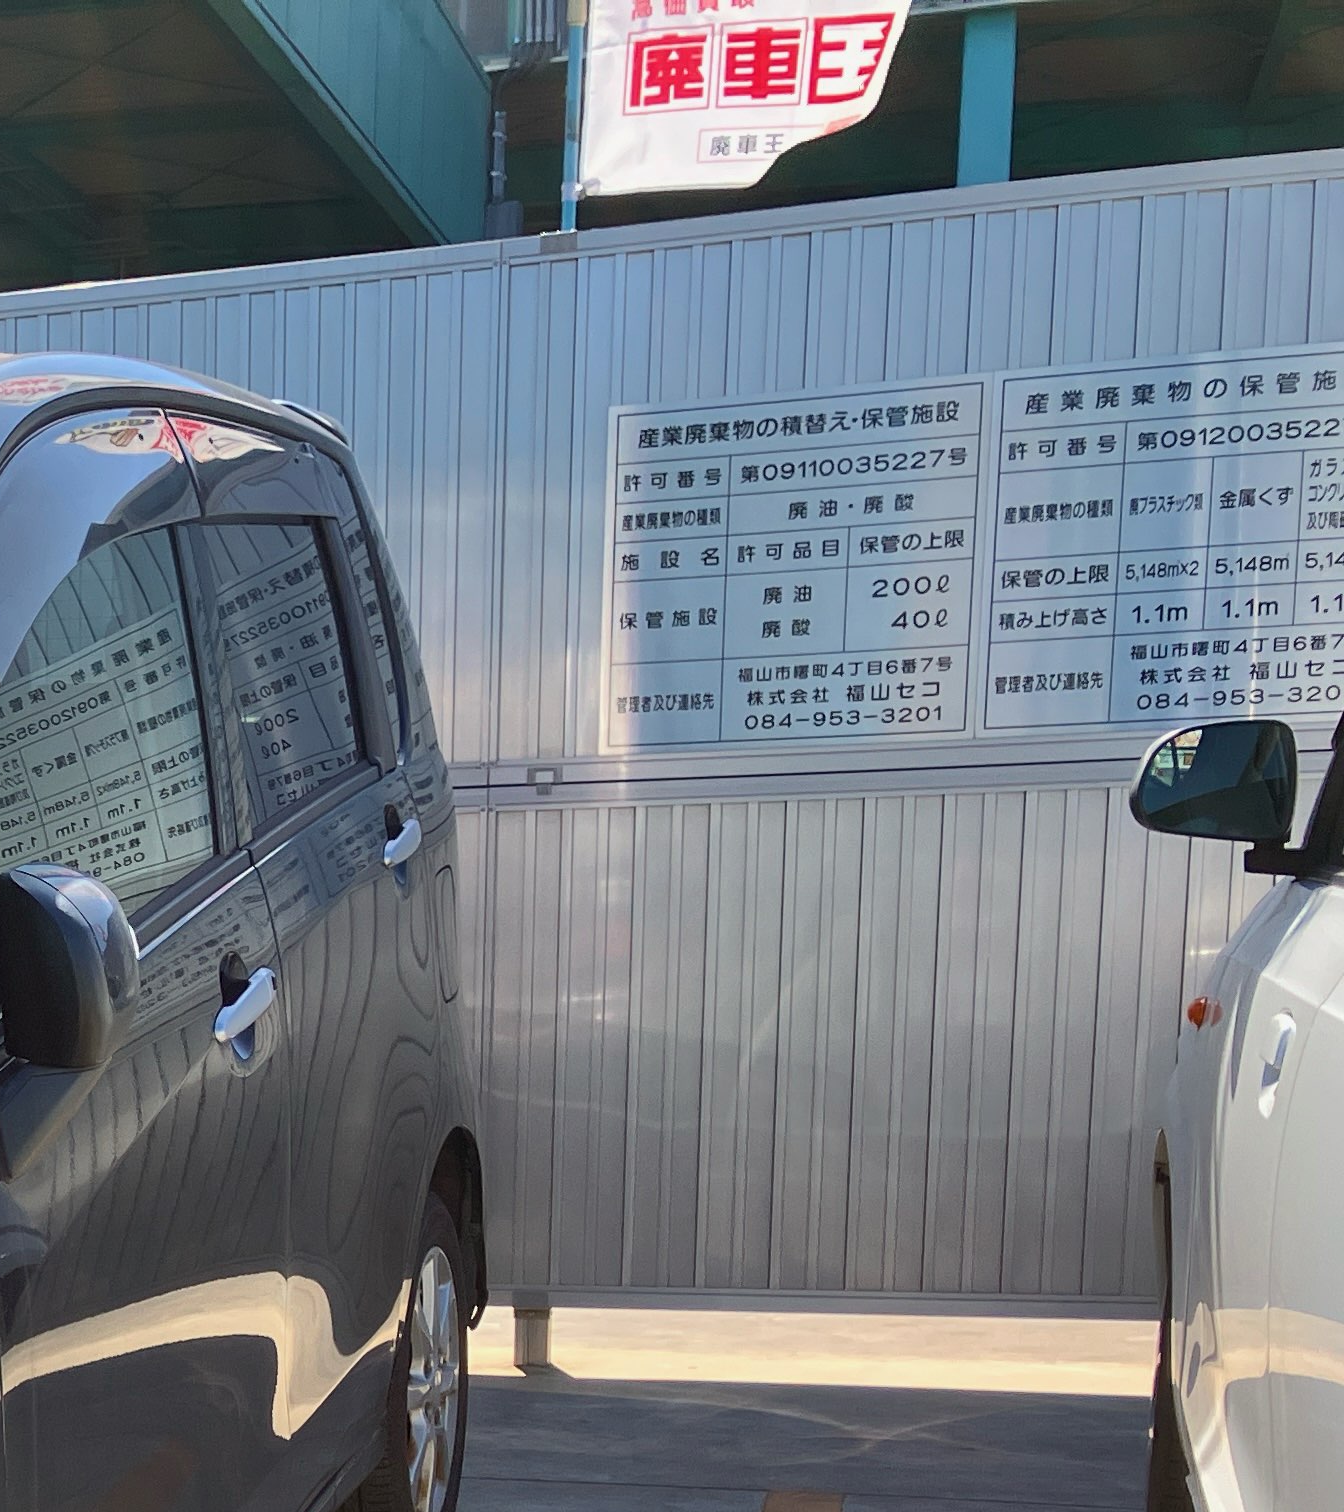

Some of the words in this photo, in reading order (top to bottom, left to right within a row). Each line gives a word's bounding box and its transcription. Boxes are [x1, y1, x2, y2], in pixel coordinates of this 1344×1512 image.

[710, 133, 785, 156] 廃車王
[1025, 370, 1337, 415] 産業廃棄物の保管施
[638, 400, 960, 449] 産業廃棄物の積替え・保管施設
[1137, 418, 1344, 451] 第0912003522
[1008, 434, 1117, 461] 許可番号
[740, 447, 968, 484] 第09110035227号
[623, 467, 722, 492] 許可番号
[788, 493, 914, 520] 廃油・廃酸
[1219, 486, 1294, 509] 金属くず
[622, 507, 721, 532] 産業廃棄物の種類
[1004, 499, 1114, 525] 産業廃棄物の種類
[737, 539, 839, 563] 許可品目
[860, 529, 964, 555] 保管の上限
[620, 547, 720, 571] 施設名
[1001, 564, 1109, 589] 保管の上限
[763, 585, 812, 605] 廃油
[620, 608, 717, 630] 保管施設
[999, 607, 1107, 631] 積み上げ高さ
[1132, 604, 1188, 624] 1.1m
[1221, 599, 1279, 619] 1.1m
[762, 619, 811, 638] 廃酸
[739, 656, 953, 683] 福山市曙町4丁目6番7号
[846, 681, 940, 702] 福山セコ
[995, 671, 1104, 694] 管理者及び連絡先
[616, 692, 714, 714] 管理者及び連絡先
[745, 706, 942, 730] 084-953-3201
